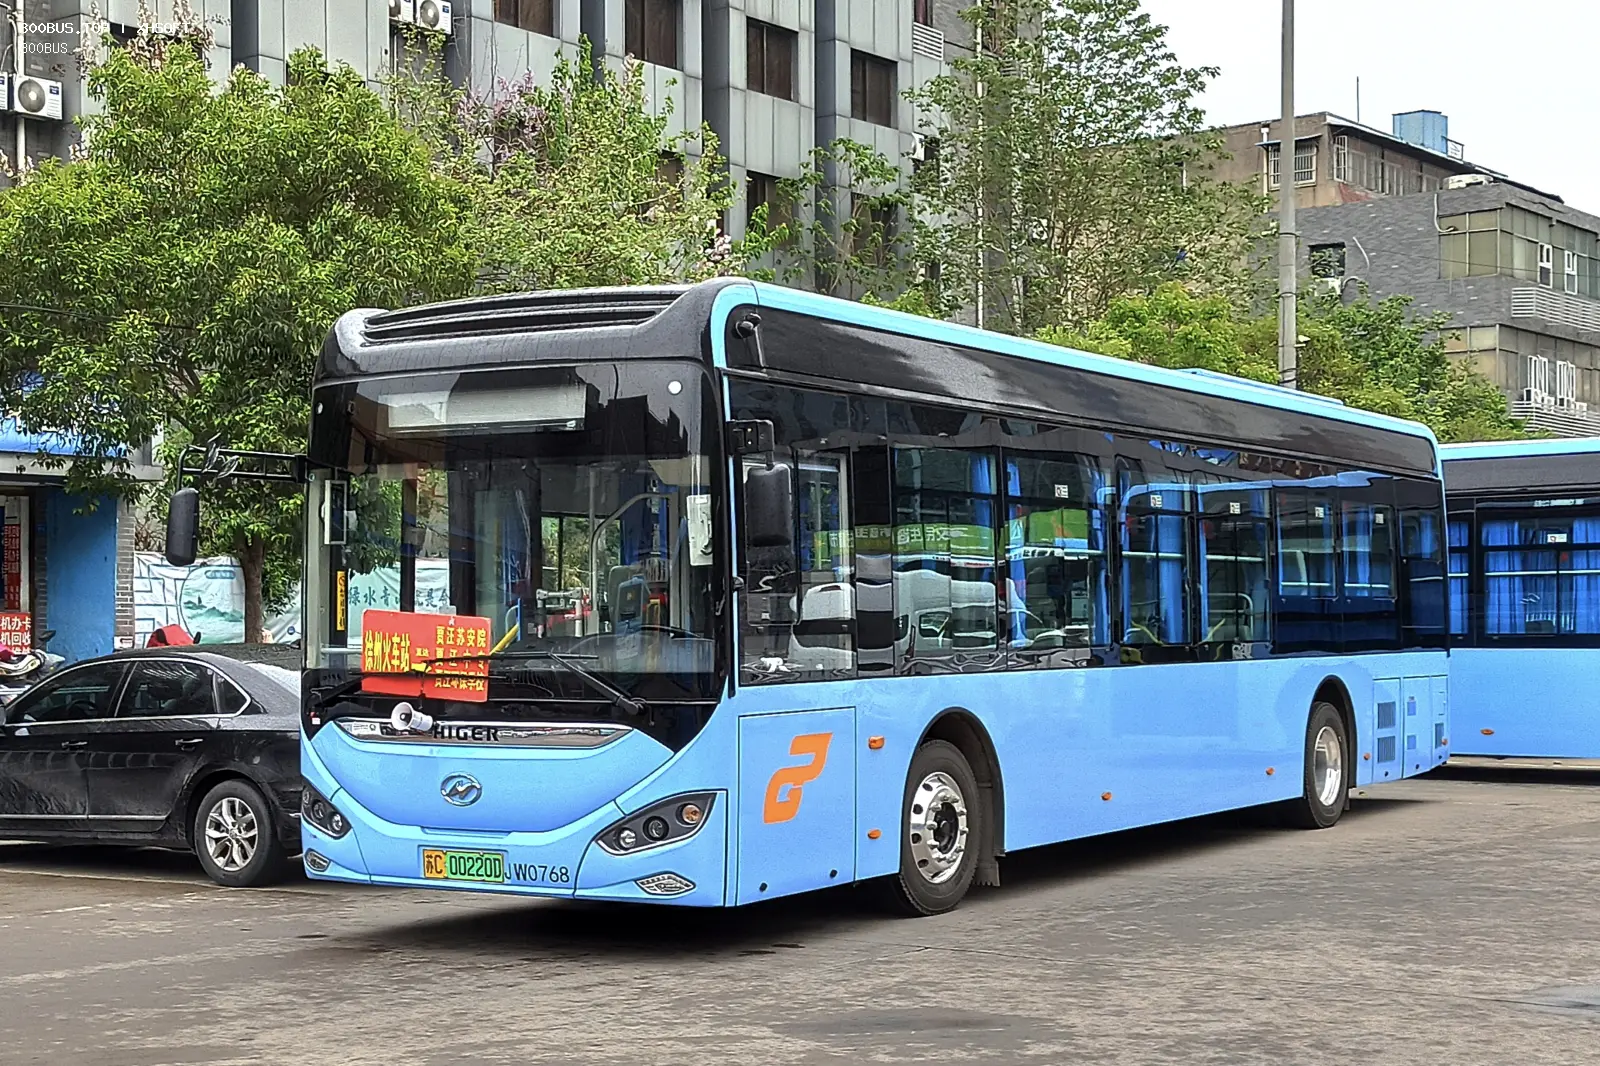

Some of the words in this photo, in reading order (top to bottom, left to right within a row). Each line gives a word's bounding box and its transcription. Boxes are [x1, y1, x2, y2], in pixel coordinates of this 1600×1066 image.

[364, 629, 410, 672] 徐州火车站
[433, 725, 499, 742] HIGER
[425, 854, 443, 875] 苏C
[504, 863, 570, 884] JW0768
